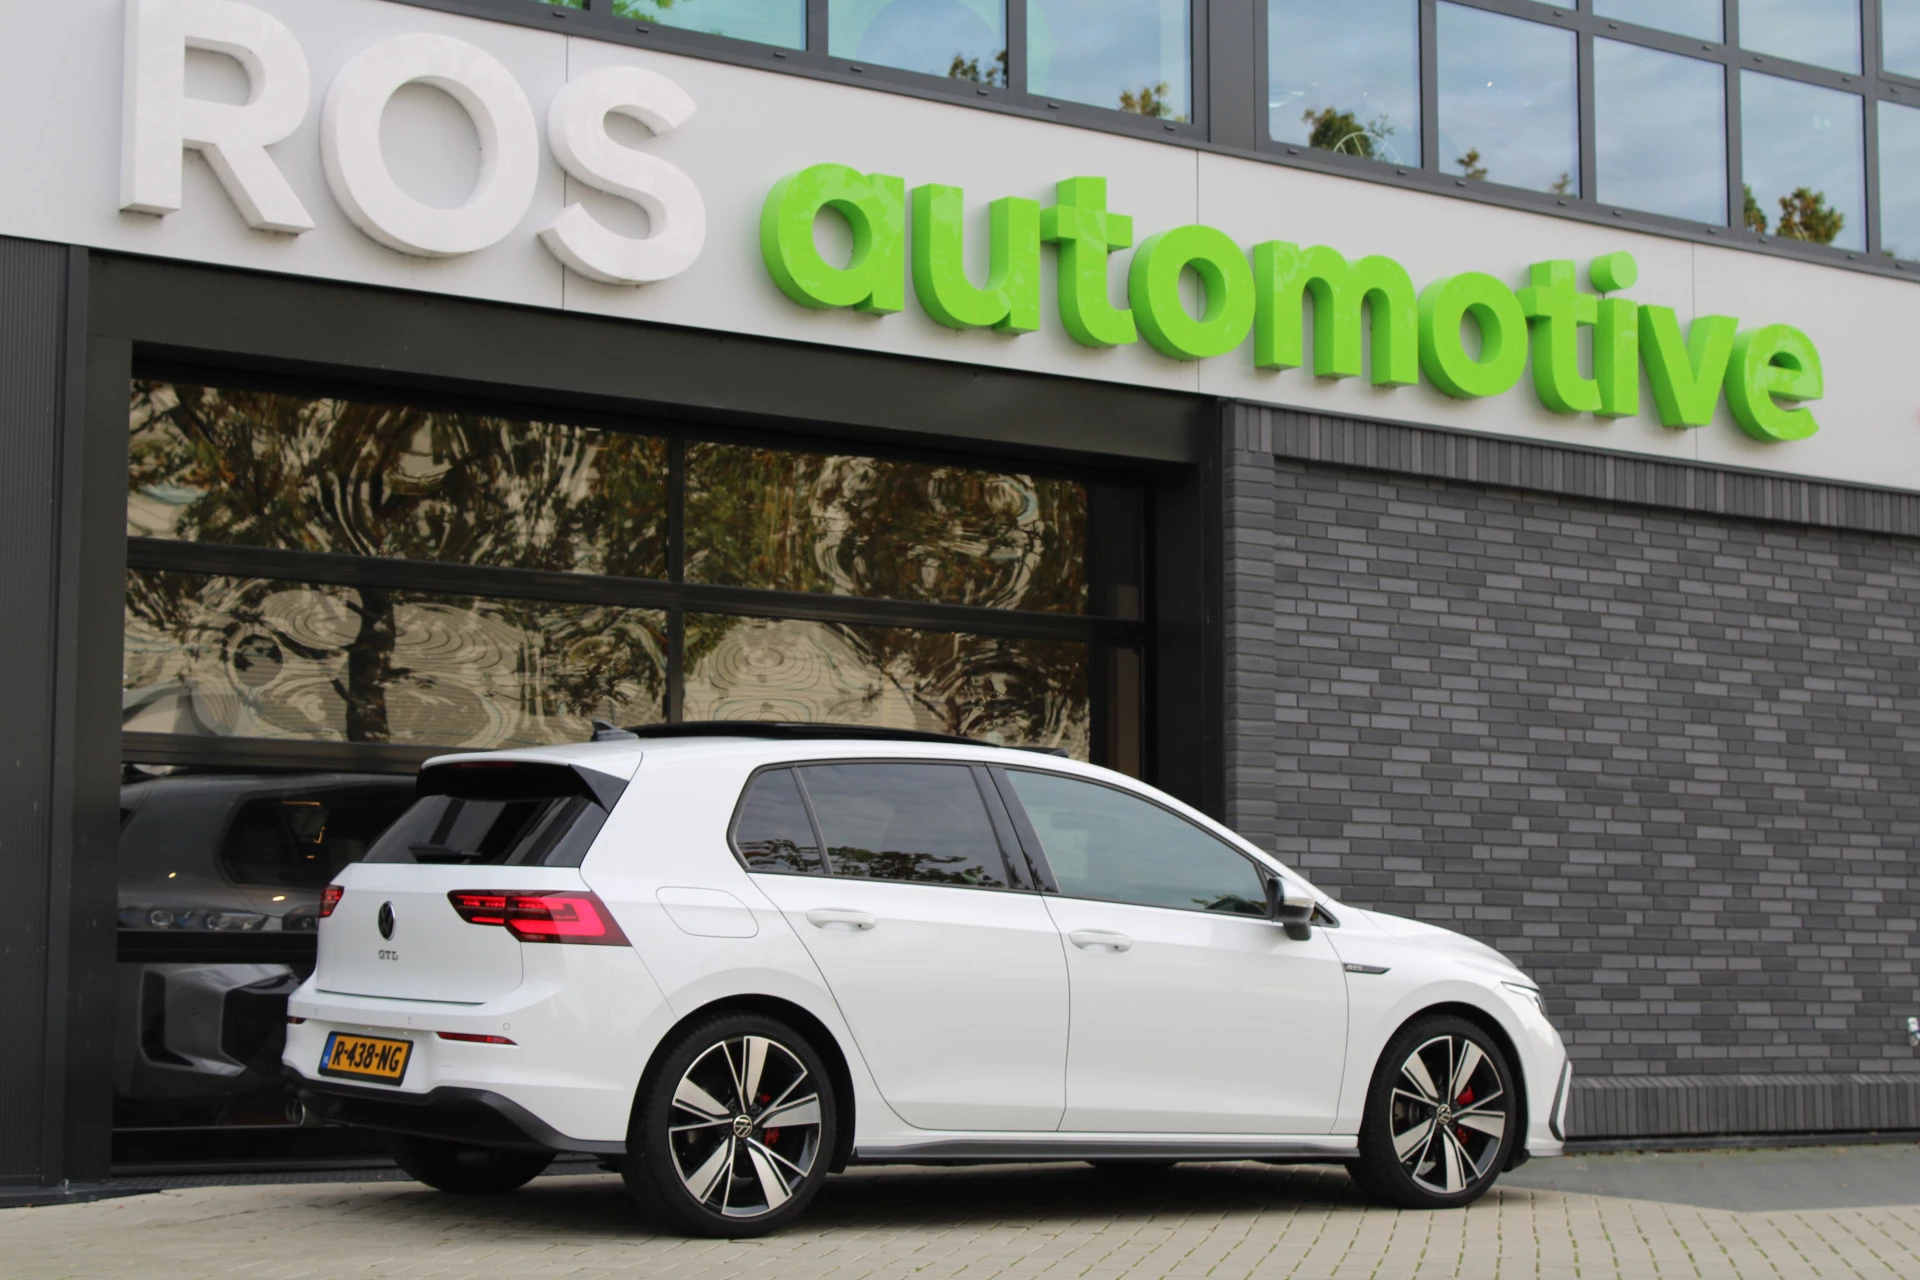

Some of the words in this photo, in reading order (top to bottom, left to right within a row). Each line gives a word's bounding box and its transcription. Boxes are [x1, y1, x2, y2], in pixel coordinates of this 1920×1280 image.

[119, 0, 707, 287] ROS
[760, 162, 1824, 444] automotive
[332, 1041, 402, 1072] R-438-NG
